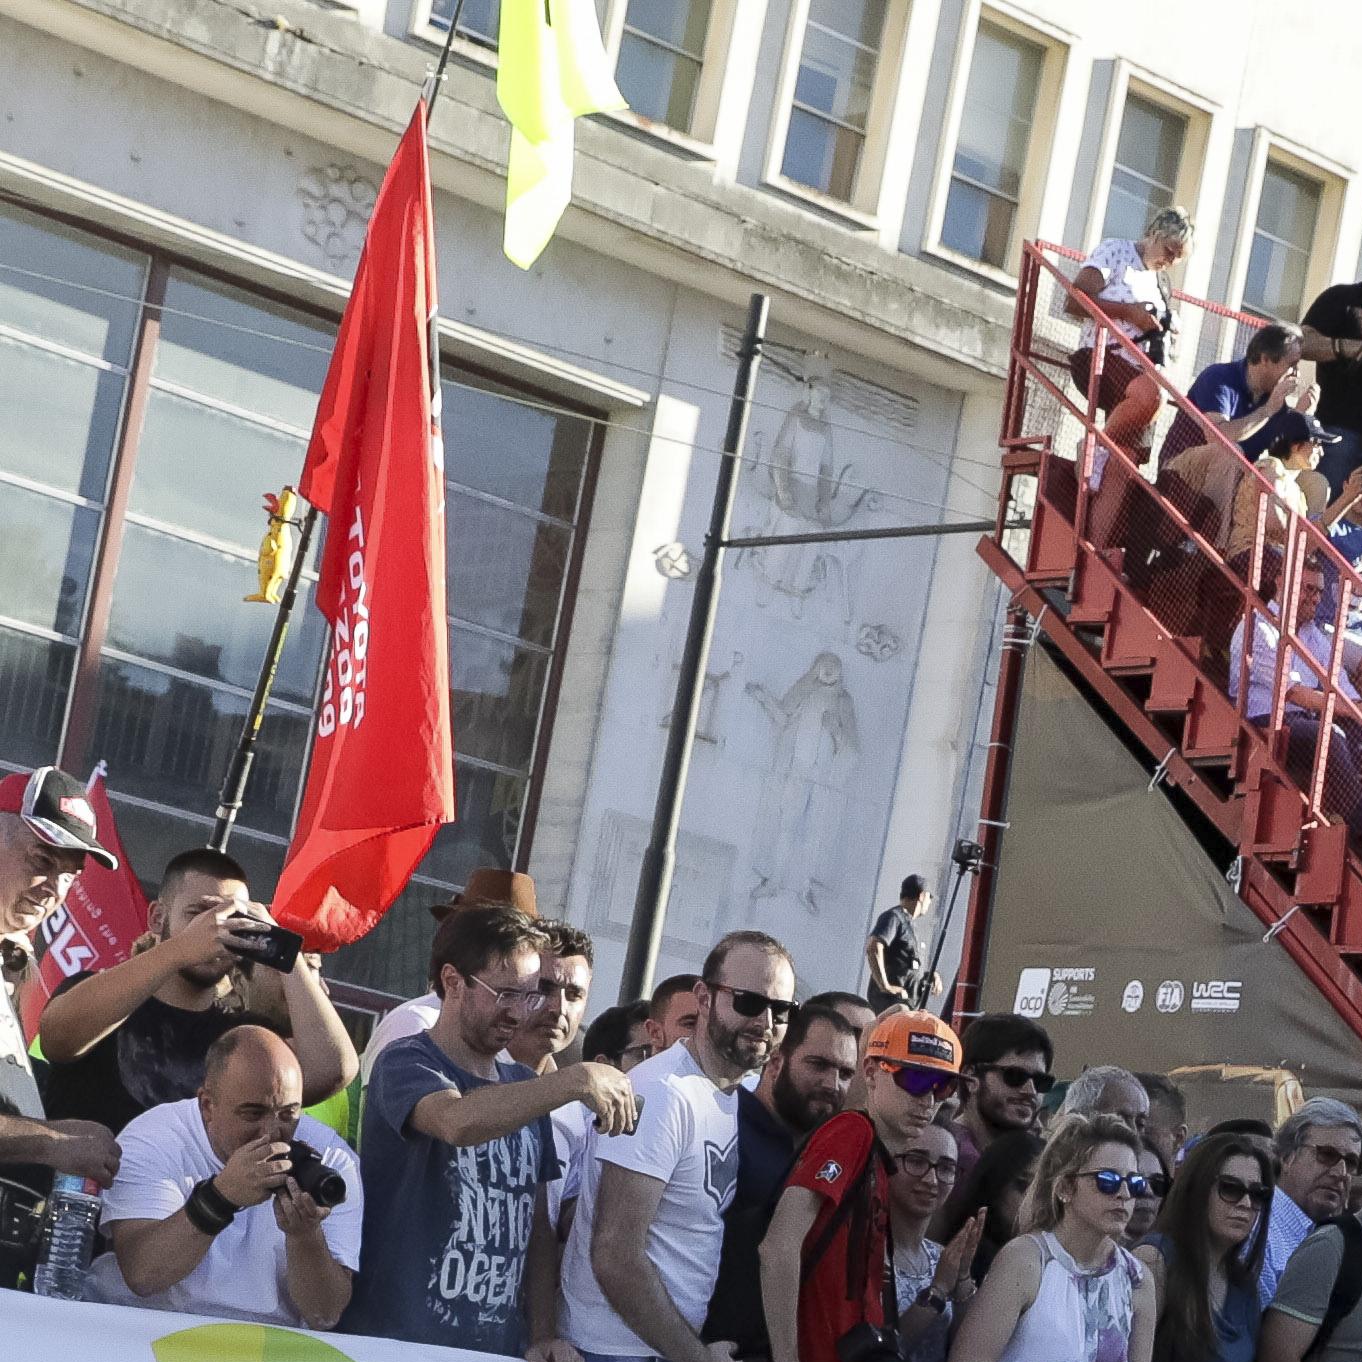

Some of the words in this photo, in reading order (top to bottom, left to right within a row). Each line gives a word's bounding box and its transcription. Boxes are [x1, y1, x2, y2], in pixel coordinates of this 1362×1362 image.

[1052, 967, 1096, 982] SUPPORTS
[1192, 981, 1243, 998] WRC
[439, 1248, 526, 1305] OCEA
